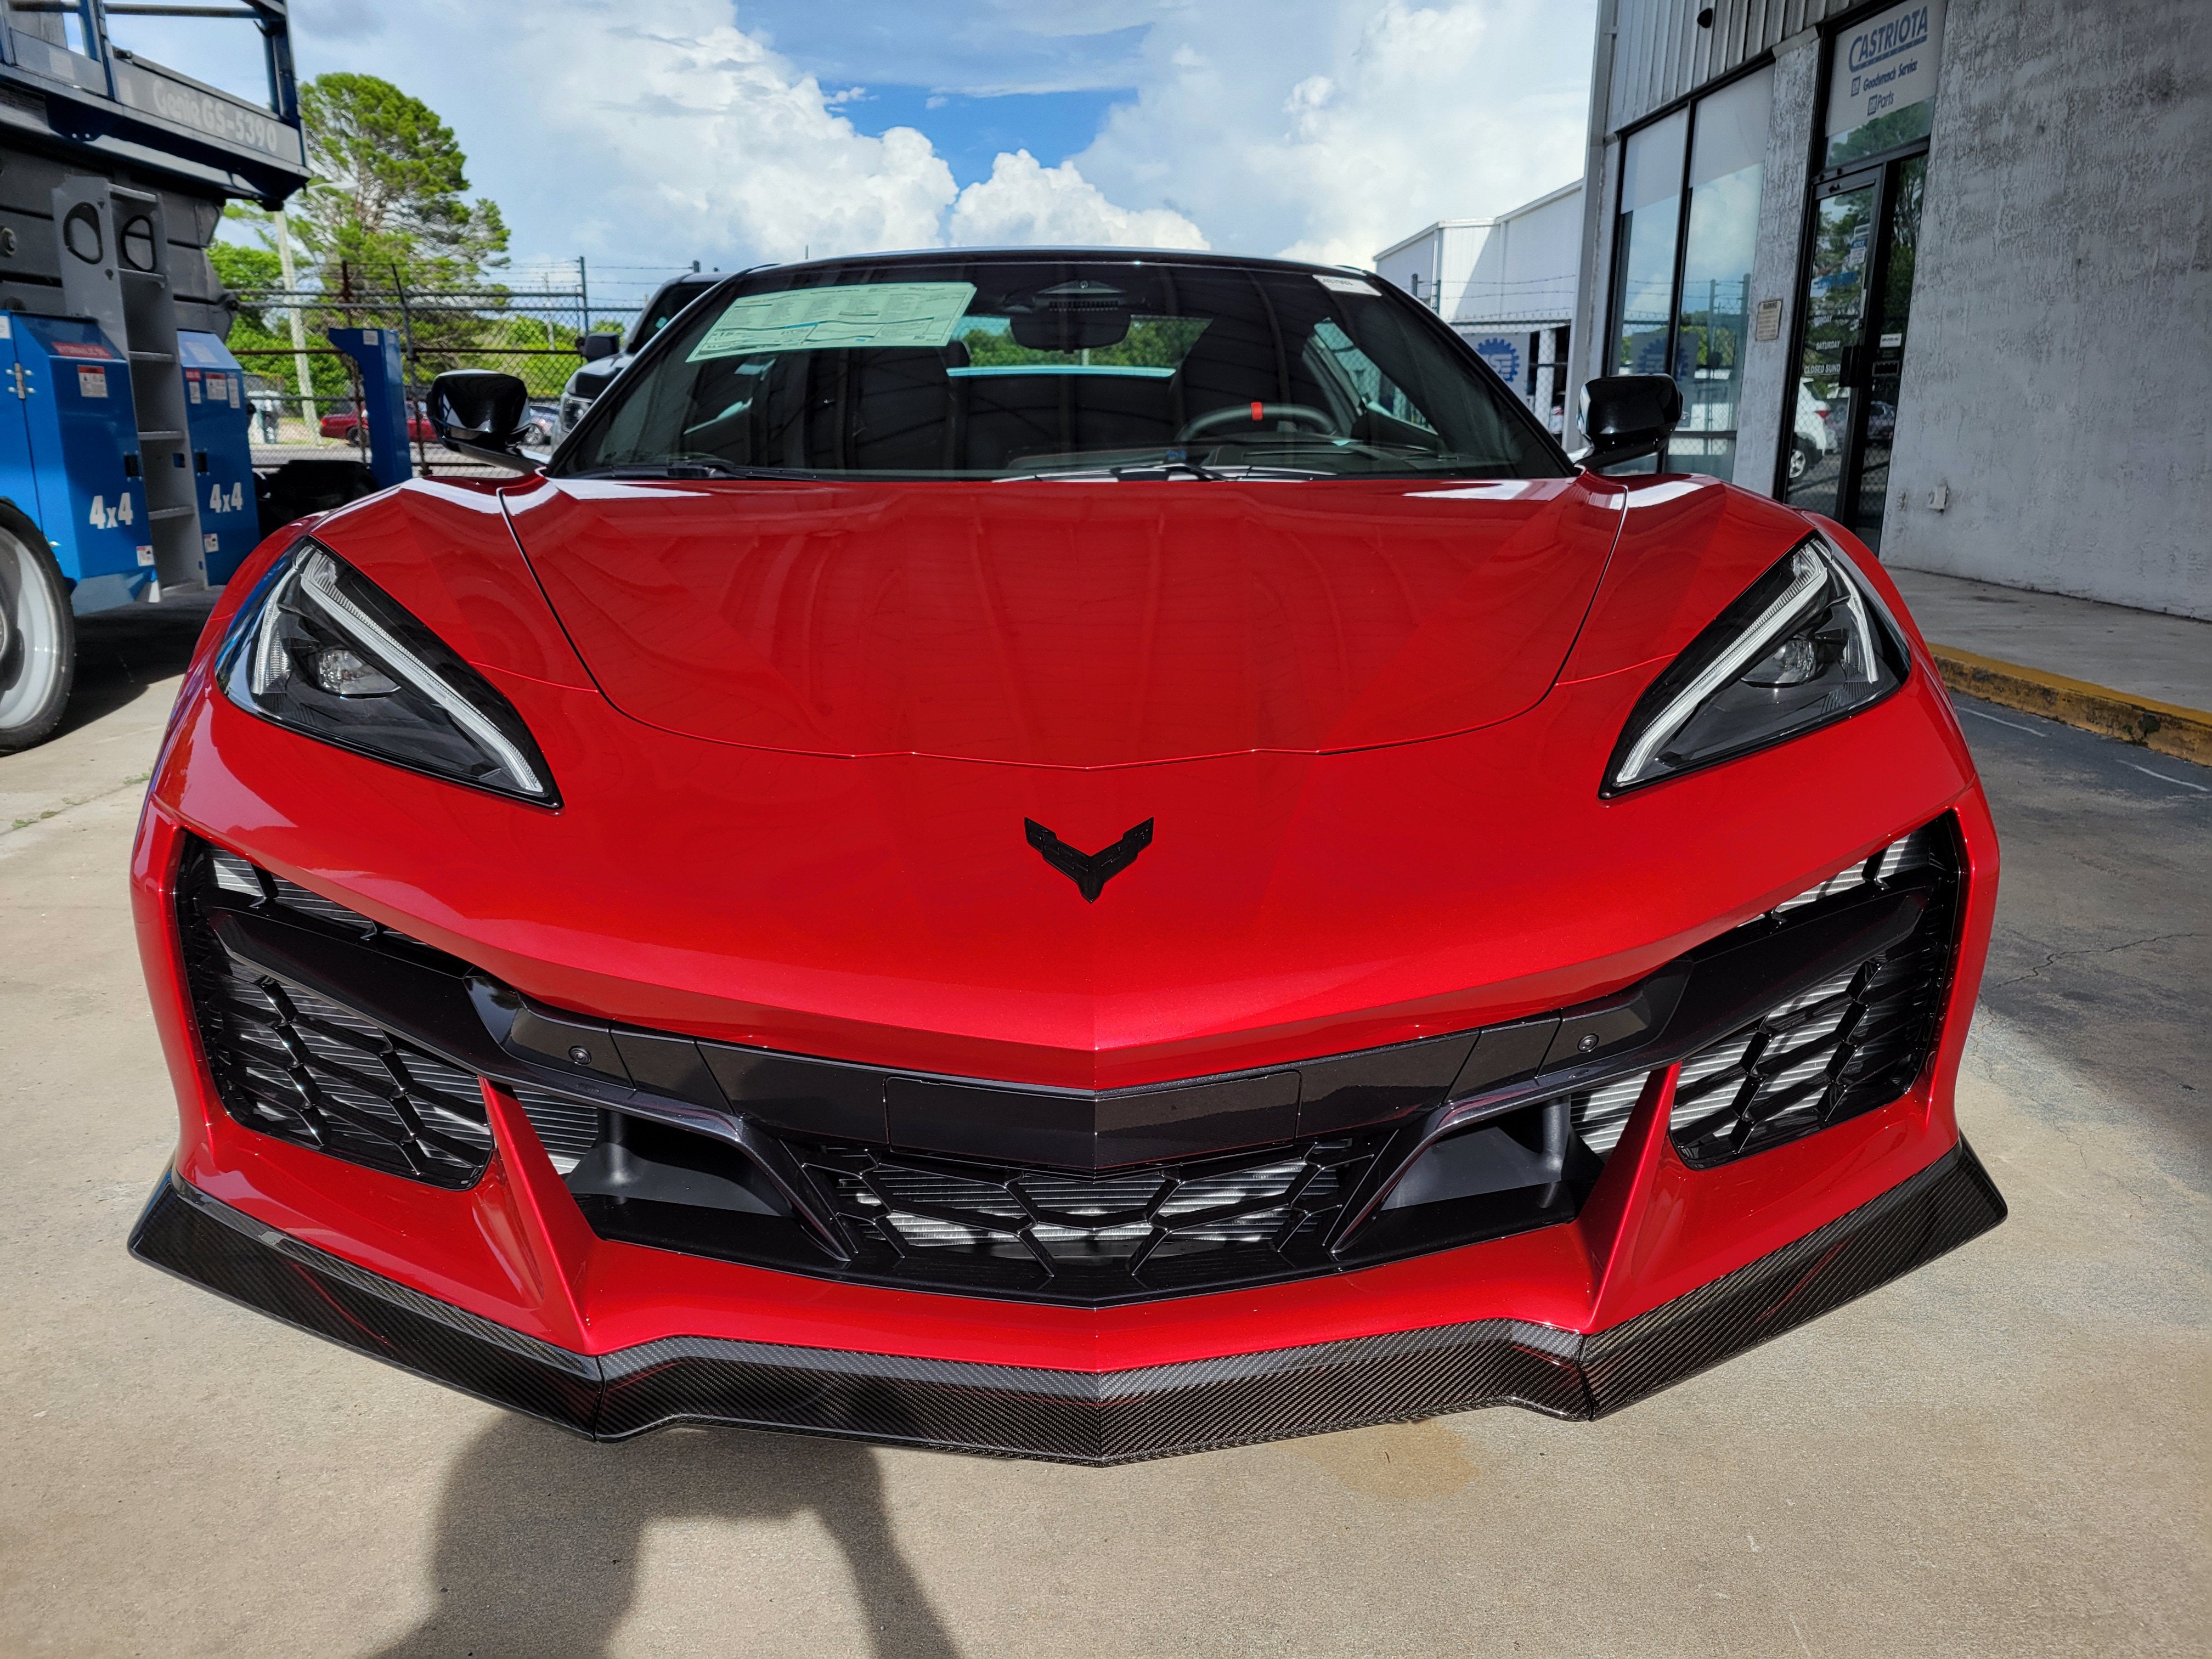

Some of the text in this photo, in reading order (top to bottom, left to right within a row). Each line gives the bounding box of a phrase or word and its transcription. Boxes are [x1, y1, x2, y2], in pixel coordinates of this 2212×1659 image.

[1849, 5, 1928, 72] CASTRIOTA
[1877, 90, 1895, 110] Parts
[1804, 363, 1841, 374] CLOSED SUND
[89, 492, 133, 529] 4x4
[210, 482, 243, 514] 4x4
